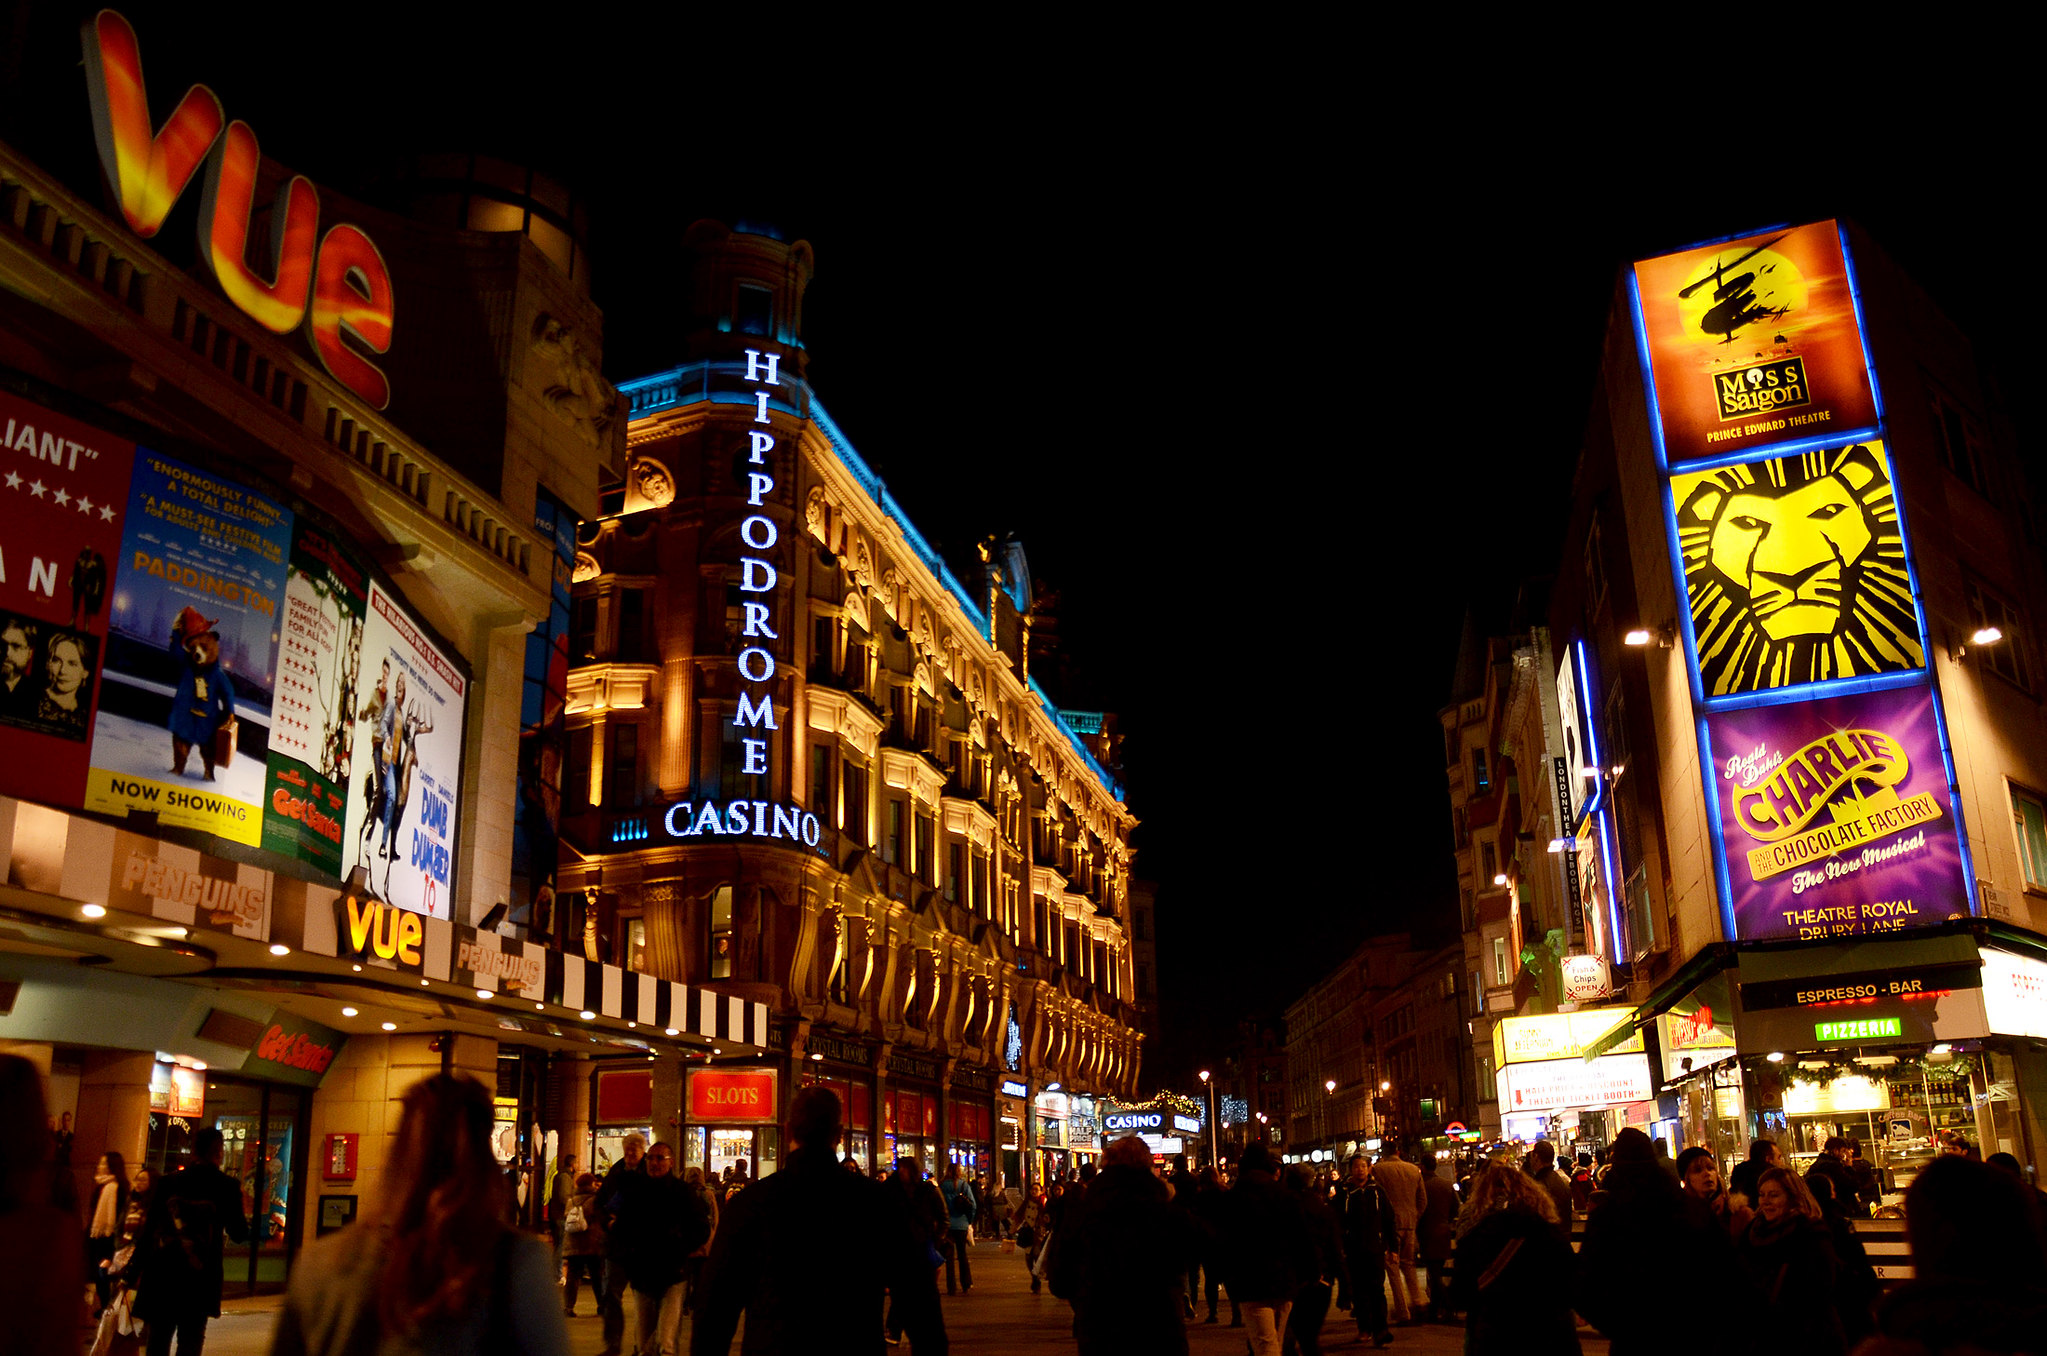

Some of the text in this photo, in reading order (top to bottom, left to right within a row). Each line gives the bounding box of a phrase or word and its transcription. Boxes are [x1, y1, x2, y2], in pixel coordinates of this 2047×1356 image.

[1707, 410, 1831, 443] PRINCE EDWARD THEATRE
[168, 481, 177, 492] A
[182, 486, 218, 508] TOTAL
[733, 349, 780, 775] HIPPODROME
[133, 551, 275, 618] PADDINGTON
[288, 620, 305, 635] FOR
[306, 629, 320, 642] ALL
[289, 609, 319, 629] FAMILY
[1724, 742, 1767, 779] Roald
[1743, 750, 1783, 787] Dahl's
[1740, 733, 1896, 833] CHARLIE
[111, 779, 160, 802] NOW
[167, 791, 247, 822] SHOWING
[273, 788, 307, 823] Get
[421, 786, 448, 840] DUMB
[665, 801, 820, 846] CASINO
[1774, 796, 1933, 867] CHOCOLATE FACTORY
[1755, 850, 1771, 864] AND
[1757, 861, 1774, 874] THE
[1792, 830, 1925, 895] The New Musical
[121, 856, 264, 921] PENGUINS
[423, 873, 436, 914] TO
[1783, 899, 1919, 926] THEATRE ROYAL
[458, 941, 540, 986] PENGUINS
[1574, 975, 1596, 983] Chips
[1797, 984, 1877, 1004] ESPRESSO
[1890, 980, 1922, 993] BAR
[257, 1024, 297, 1063] Get
[1630, 1039, 1640, 1049] ME
[1822, 1020, 1896, 1039] PIZZERIA
[707, 1087, 759, 1104] SLOTS
[1070, 1126, 1092, 1135] HALF
[1105, 1114, 1162, 1129] CASINO
[1878, 1110, 1921, 1123] Coffee Bar
